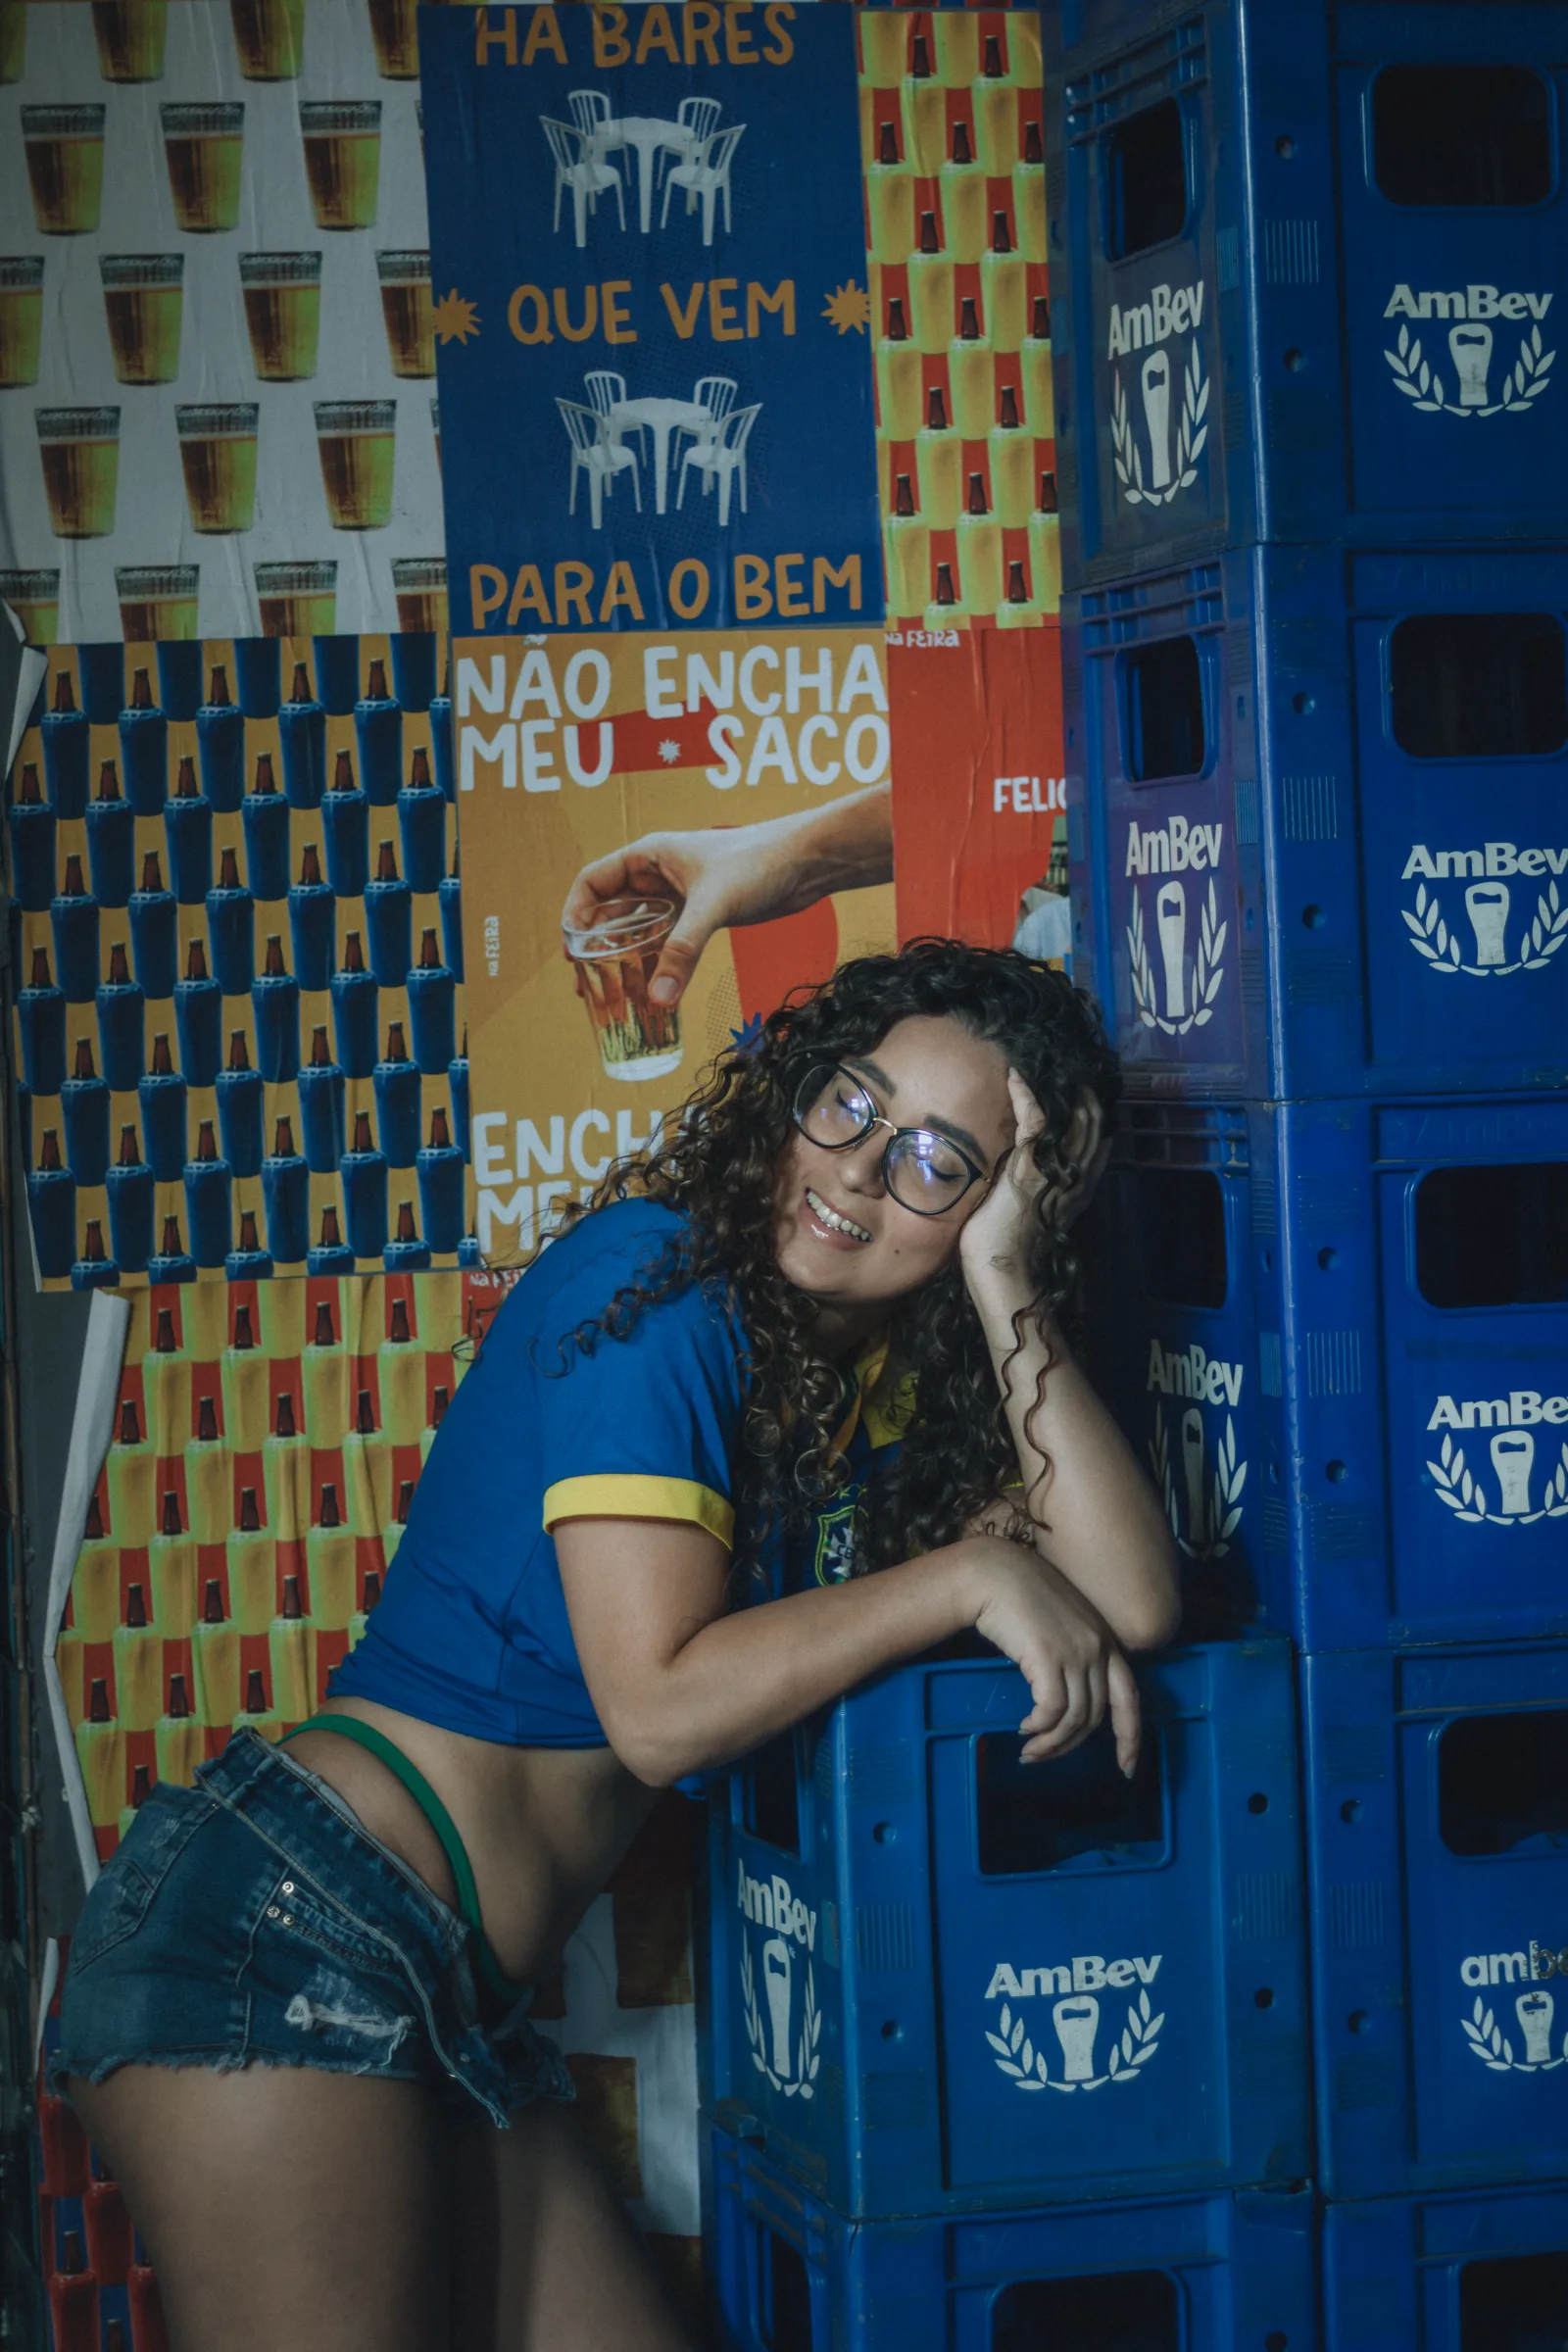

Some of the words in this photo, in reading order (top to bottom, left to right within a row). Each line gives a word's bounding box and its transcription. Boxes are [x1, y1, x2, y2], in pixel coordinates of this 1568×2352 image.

[592, 3, 796, 68] BARES
[508, 280, 637, 345] QUE
[661, 278, 796, 342] VEM
[1108, 280, 1204, 361] AmBev
[1383, 284, 1553, 320] AmBev
[469, 561, 645, 630] PARA
[668, 559, 710, 619] O
[735, 553, 861, 620] BEM
[457, 633, 612, 720] NÃO
[643, 644, 890, 719] ENCHA
[460, 718, 614, 793] MEU
[705, 713, 891, 790] SACO
[1125, 815, 1223, 877] AmBev
[1400, 843, 1568, 880] AmBev
[1147, 1339, 1244, 1407] AmBev
[1426, 1391, 1568, 1431] AmBe
[837, 1544, 854, 1559] CB
[737, 1857, 816, 1952] AmBev
[984, 1955, 1163, 2000] AmBev
